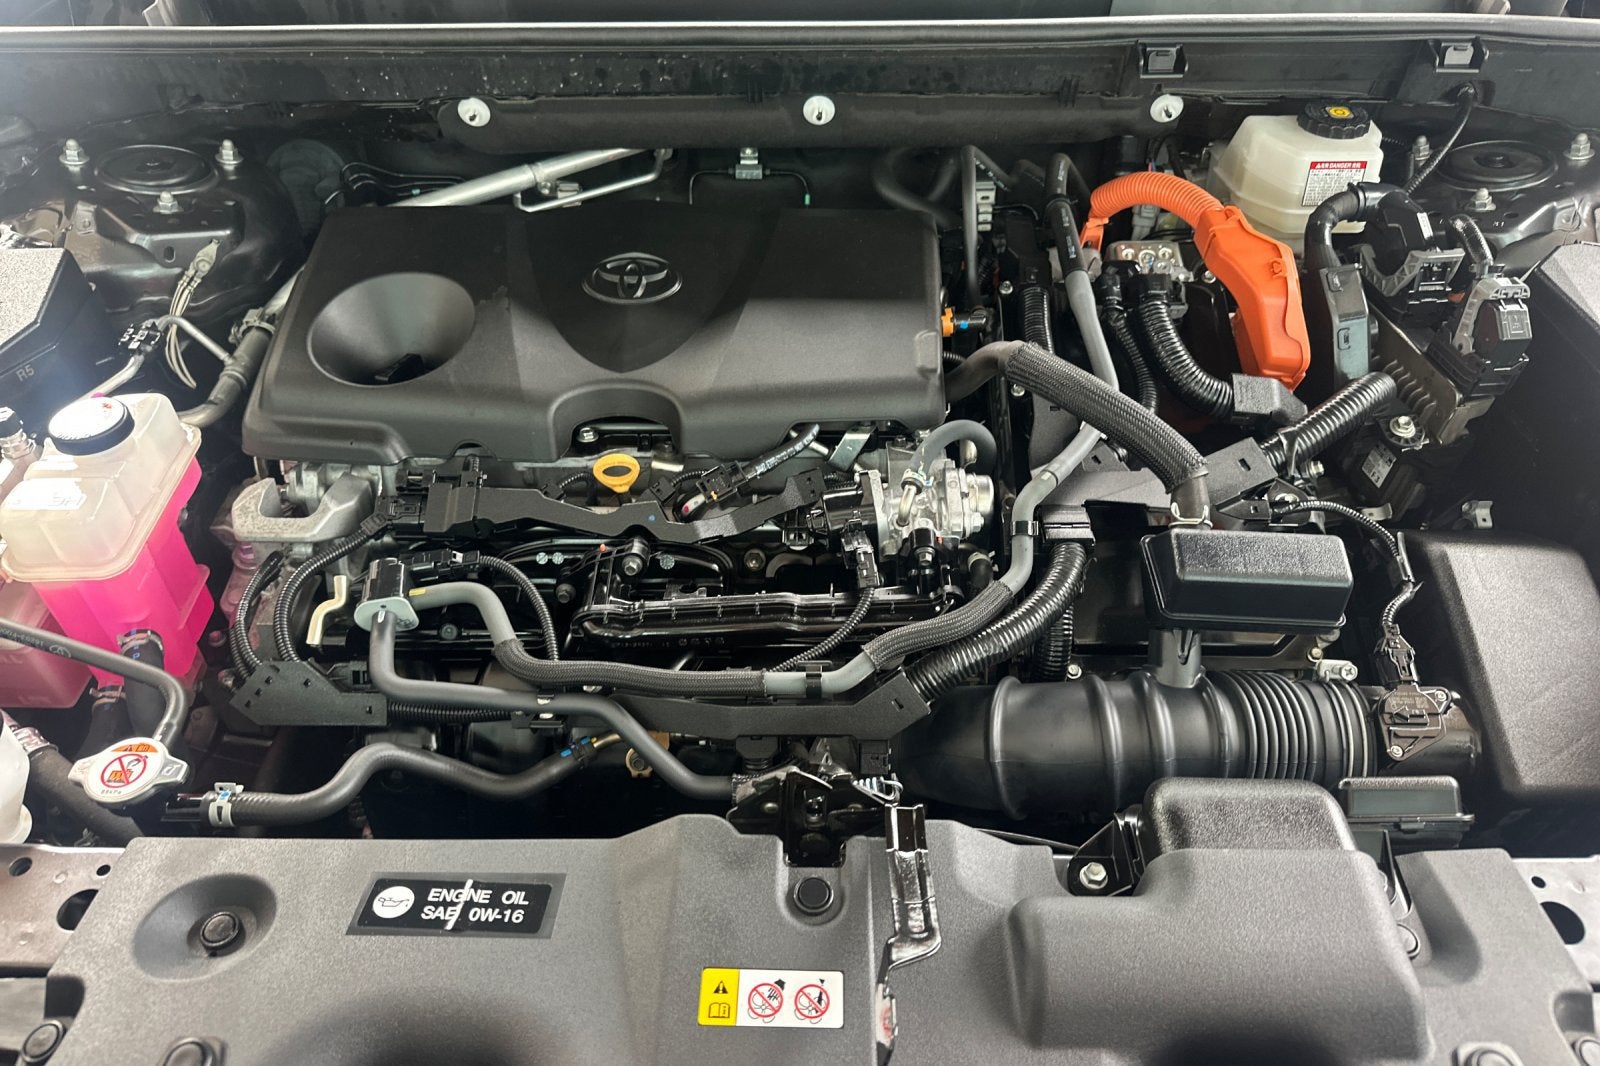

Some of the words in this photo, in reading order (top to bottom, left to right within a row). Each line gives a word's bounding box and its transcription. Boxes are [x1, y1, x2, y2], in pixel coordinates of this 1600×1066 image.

[16, 364, 34, 381] R5
[501, 890, 529, 905] OIL
[421, 905, 458, 920] SAE
[468, 907, 524, 923] 0W-16
